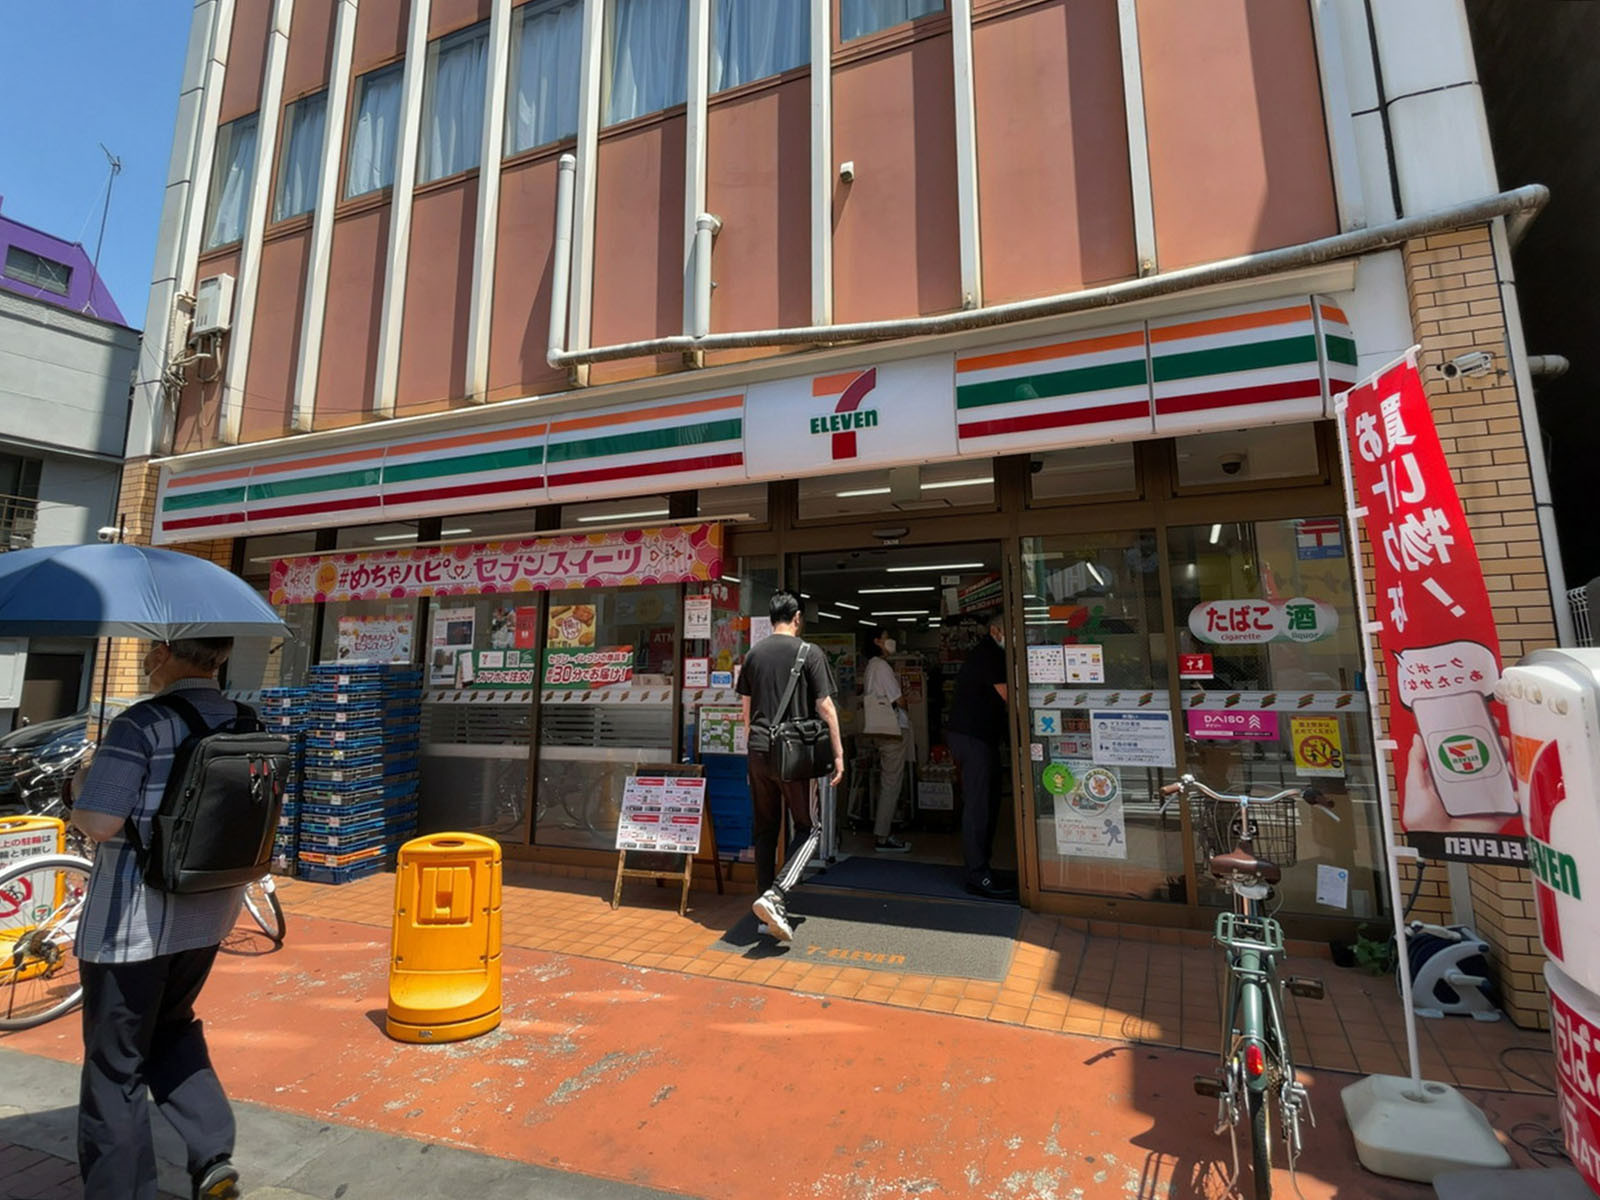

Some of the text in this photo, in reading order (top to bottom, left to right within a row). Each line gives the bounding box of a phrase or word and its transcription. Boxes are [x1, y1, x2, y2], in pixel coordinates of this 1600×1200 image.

[473, 546, 642, 583] セブンスイーツ
[1206, 604, 1318, 632] たばこ 酒
[1221, 632, 1262, 642] cigarette
[1204, 714, 1245, 723] DAISO
